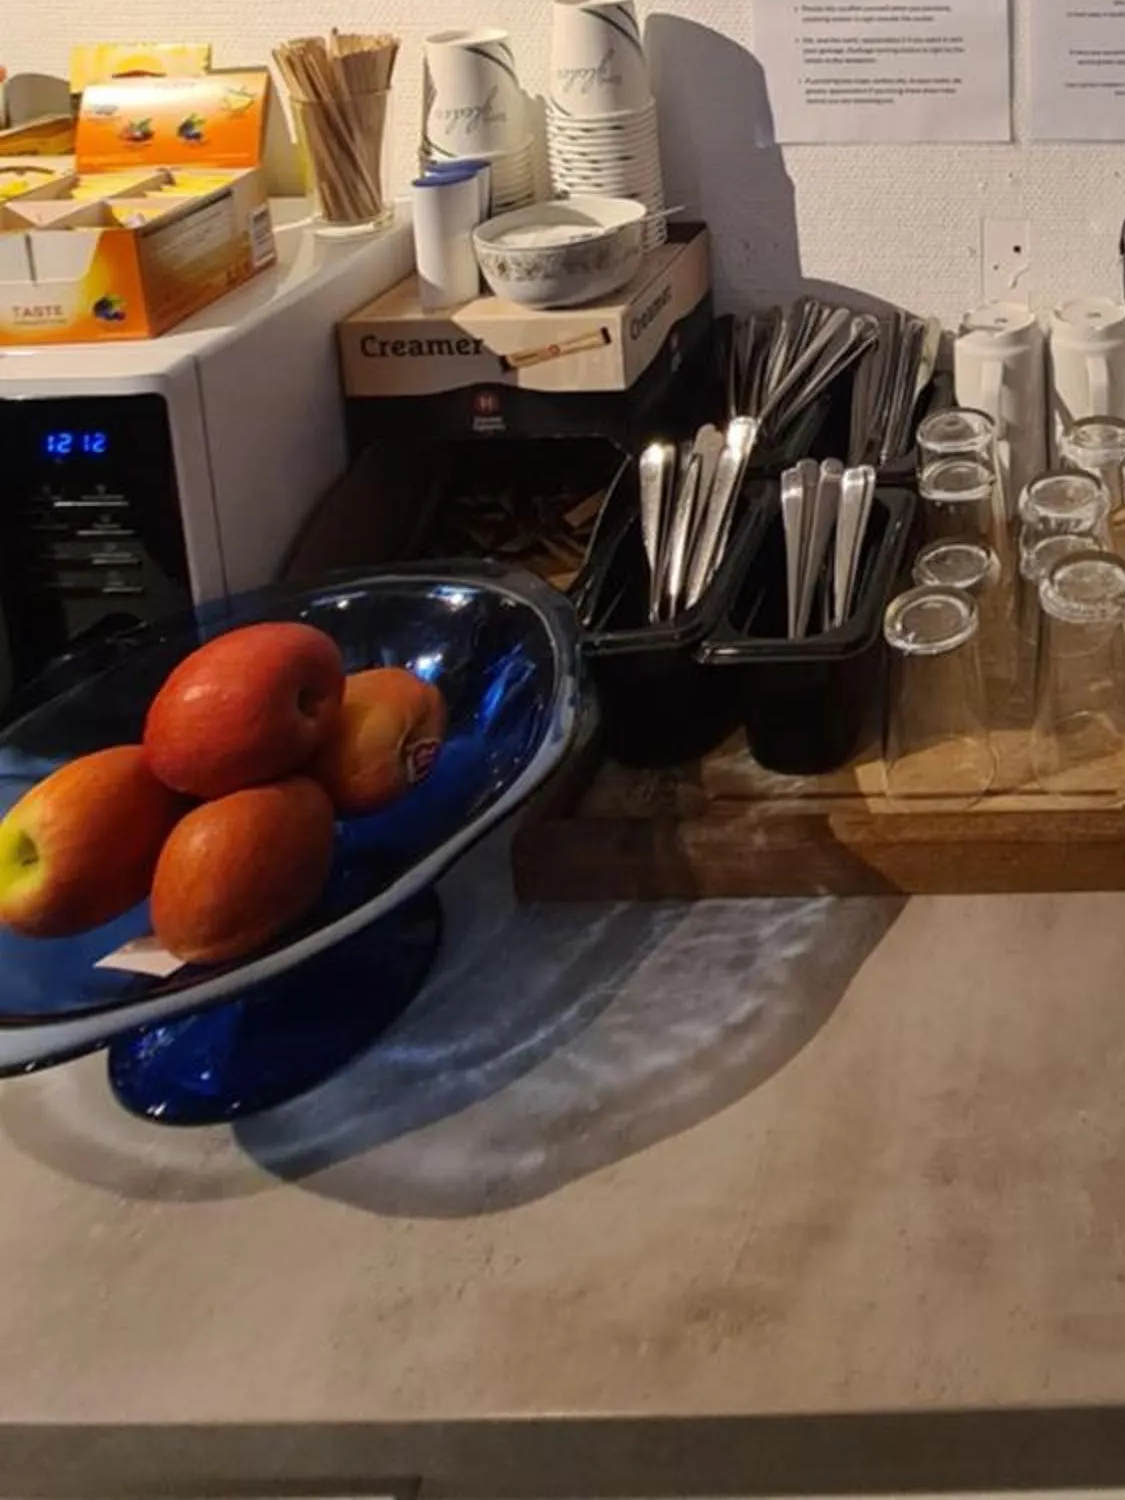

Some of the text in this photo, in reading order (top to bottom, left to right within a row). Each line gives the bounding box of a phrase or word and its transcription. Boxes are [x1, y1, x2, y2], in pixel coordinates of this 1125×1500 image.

[12, 304, 64, 319] TASTE
[629, 284, 673, 341] Creamer
[360, 334, 484, 358] Creamer
